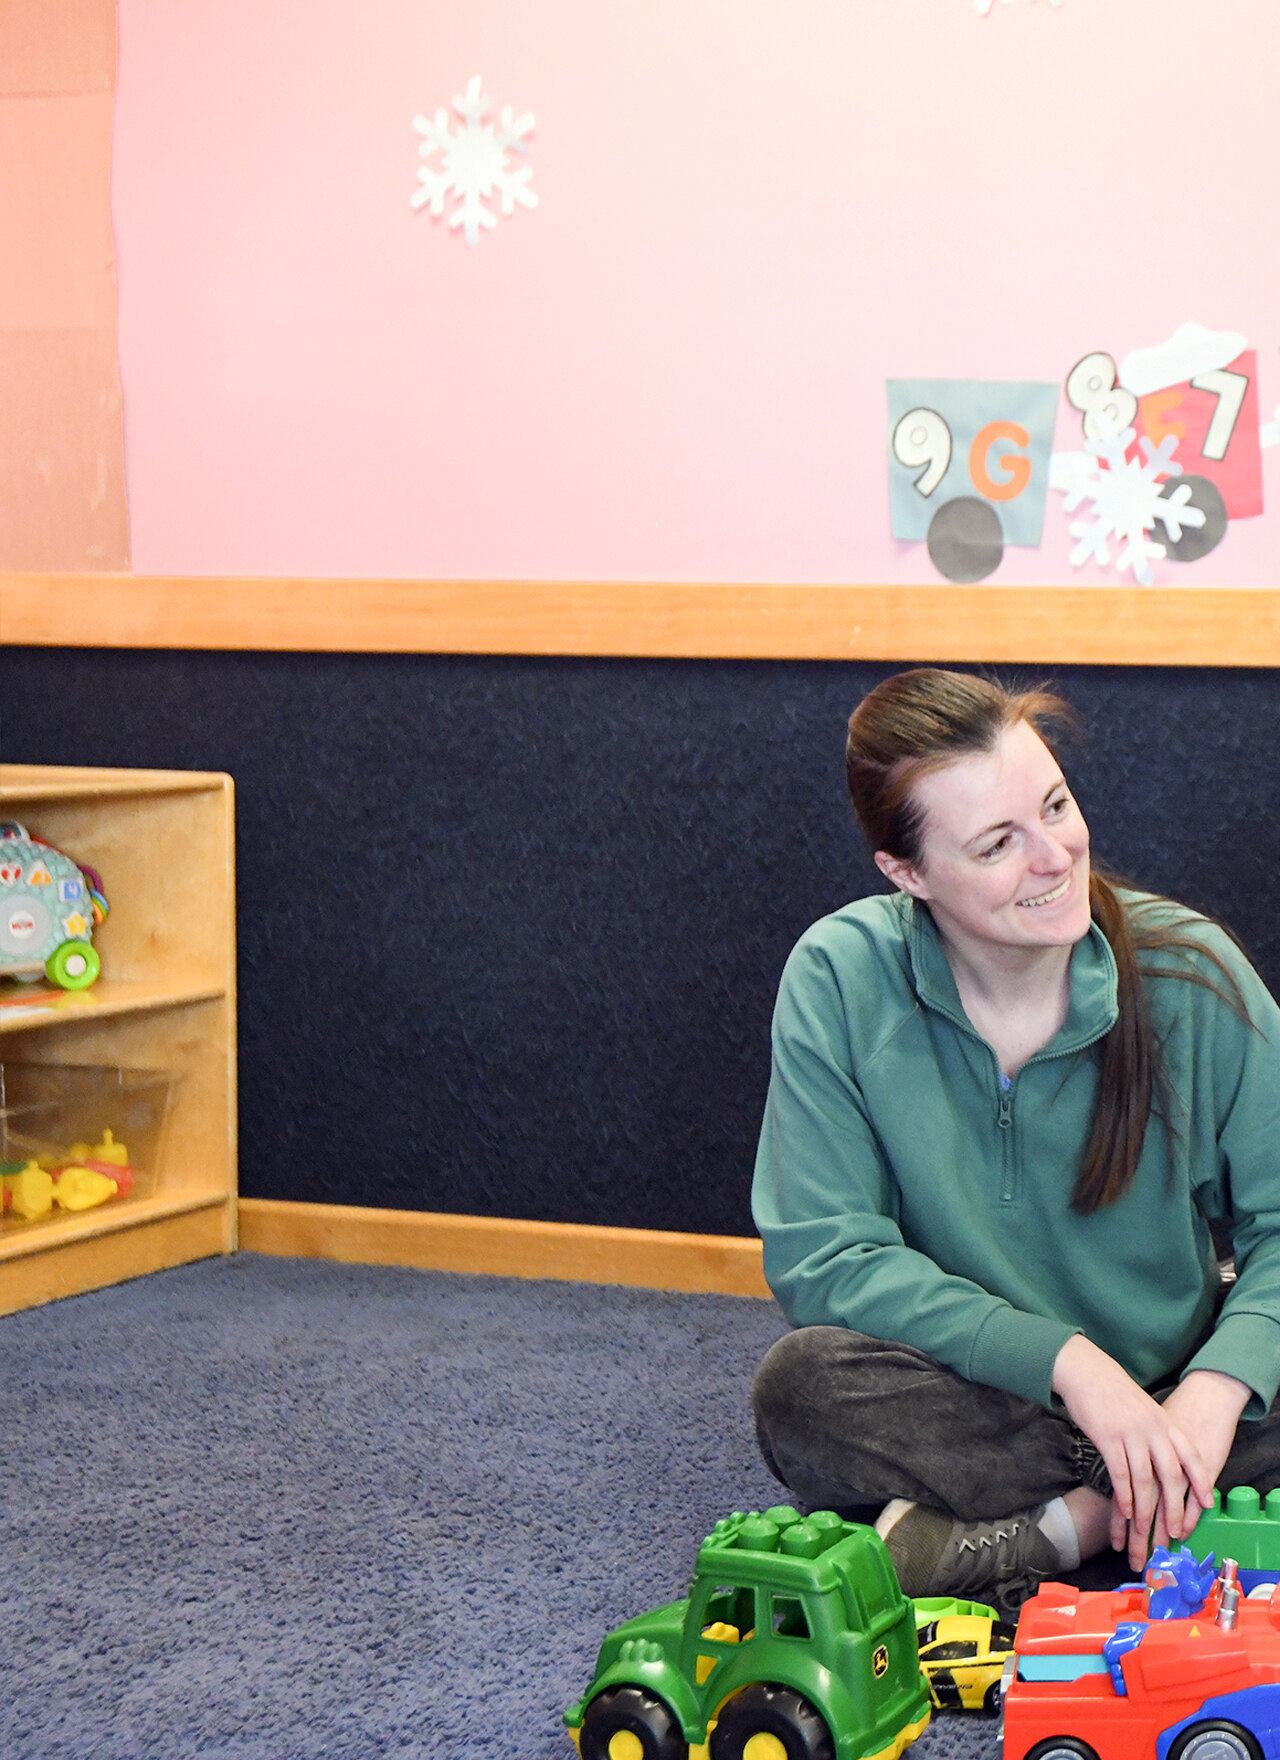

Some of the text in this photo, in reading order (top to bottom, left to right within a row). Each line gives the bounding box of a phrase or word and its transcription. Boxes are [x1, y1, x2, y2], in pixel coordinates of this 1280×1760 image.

[1066, 351, 1139, 443] 8
[1190, 368, 1249, 461] 7
[892, 406, 1032, 501] 9 G
